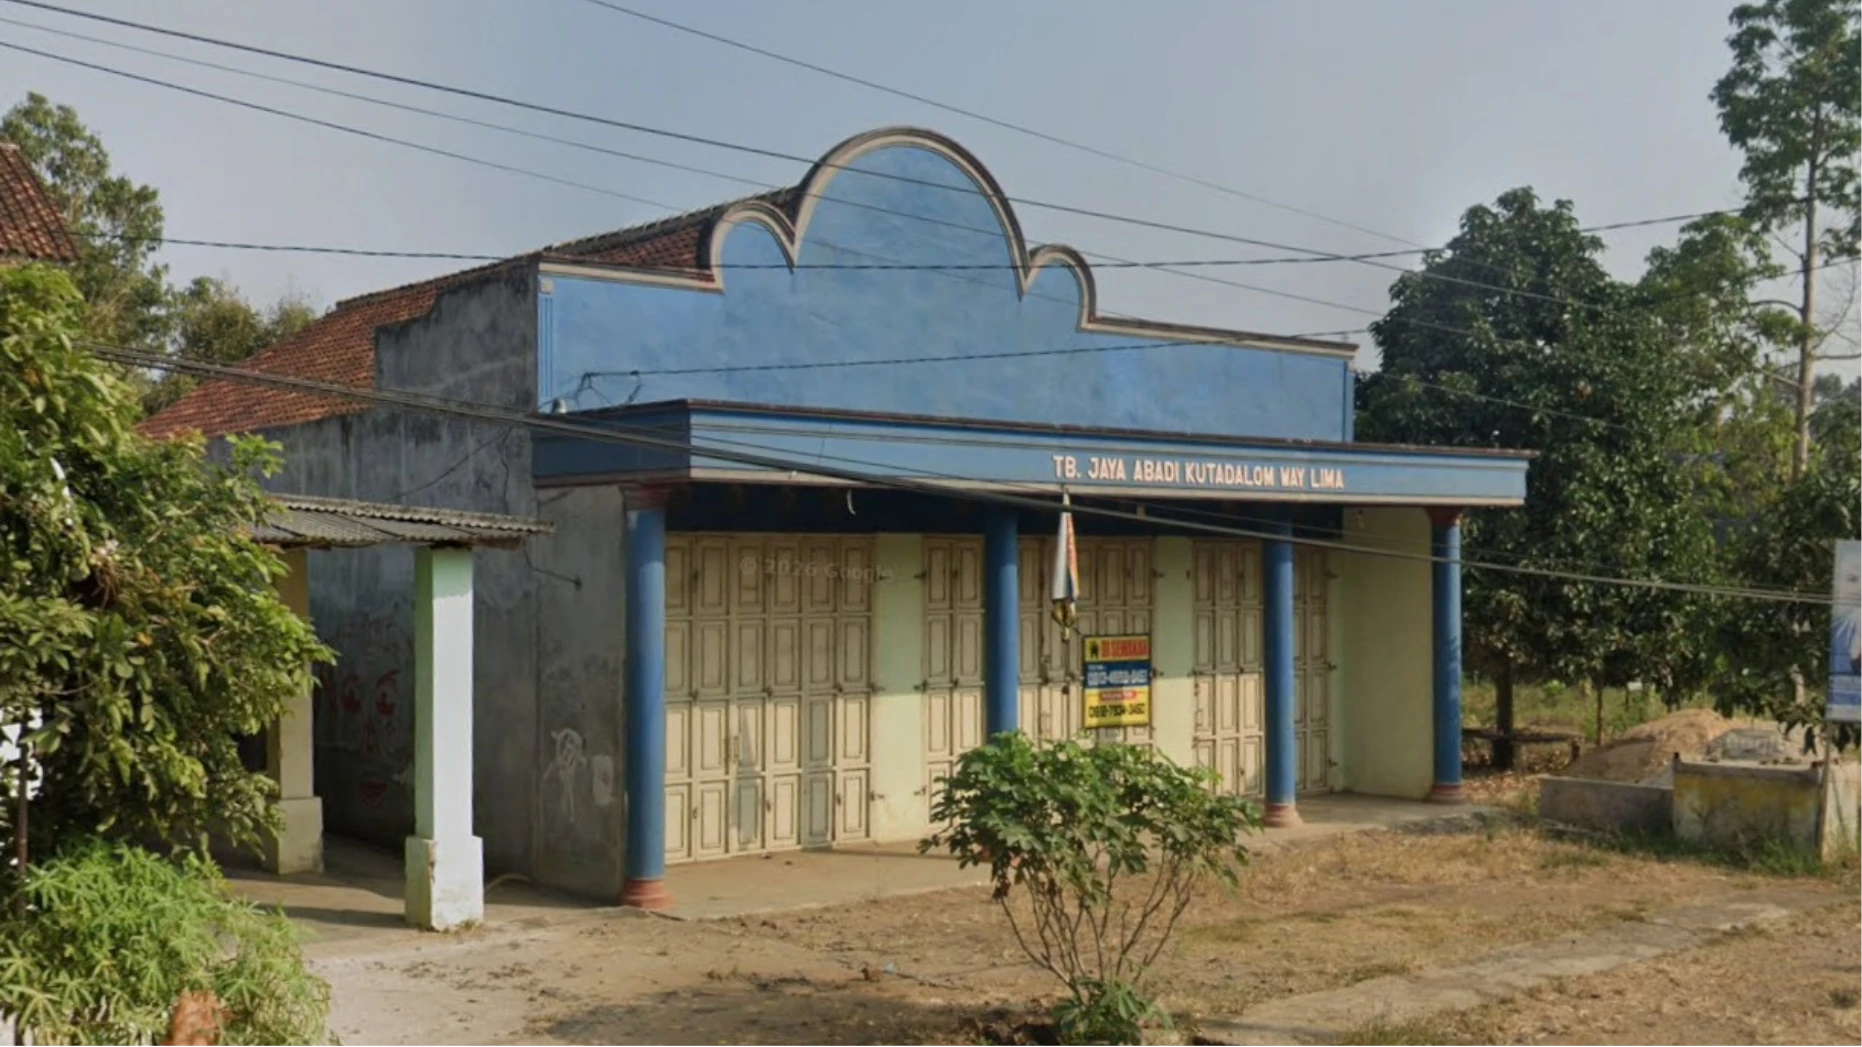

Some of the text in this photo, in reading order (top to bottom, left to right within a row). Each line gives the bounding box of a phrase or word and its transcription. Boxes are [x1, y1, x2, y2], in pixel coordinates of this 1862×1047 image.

[1053, 455, 1344, 488] TB. JAYA ABADI KUTADALOM WAY LIMA
